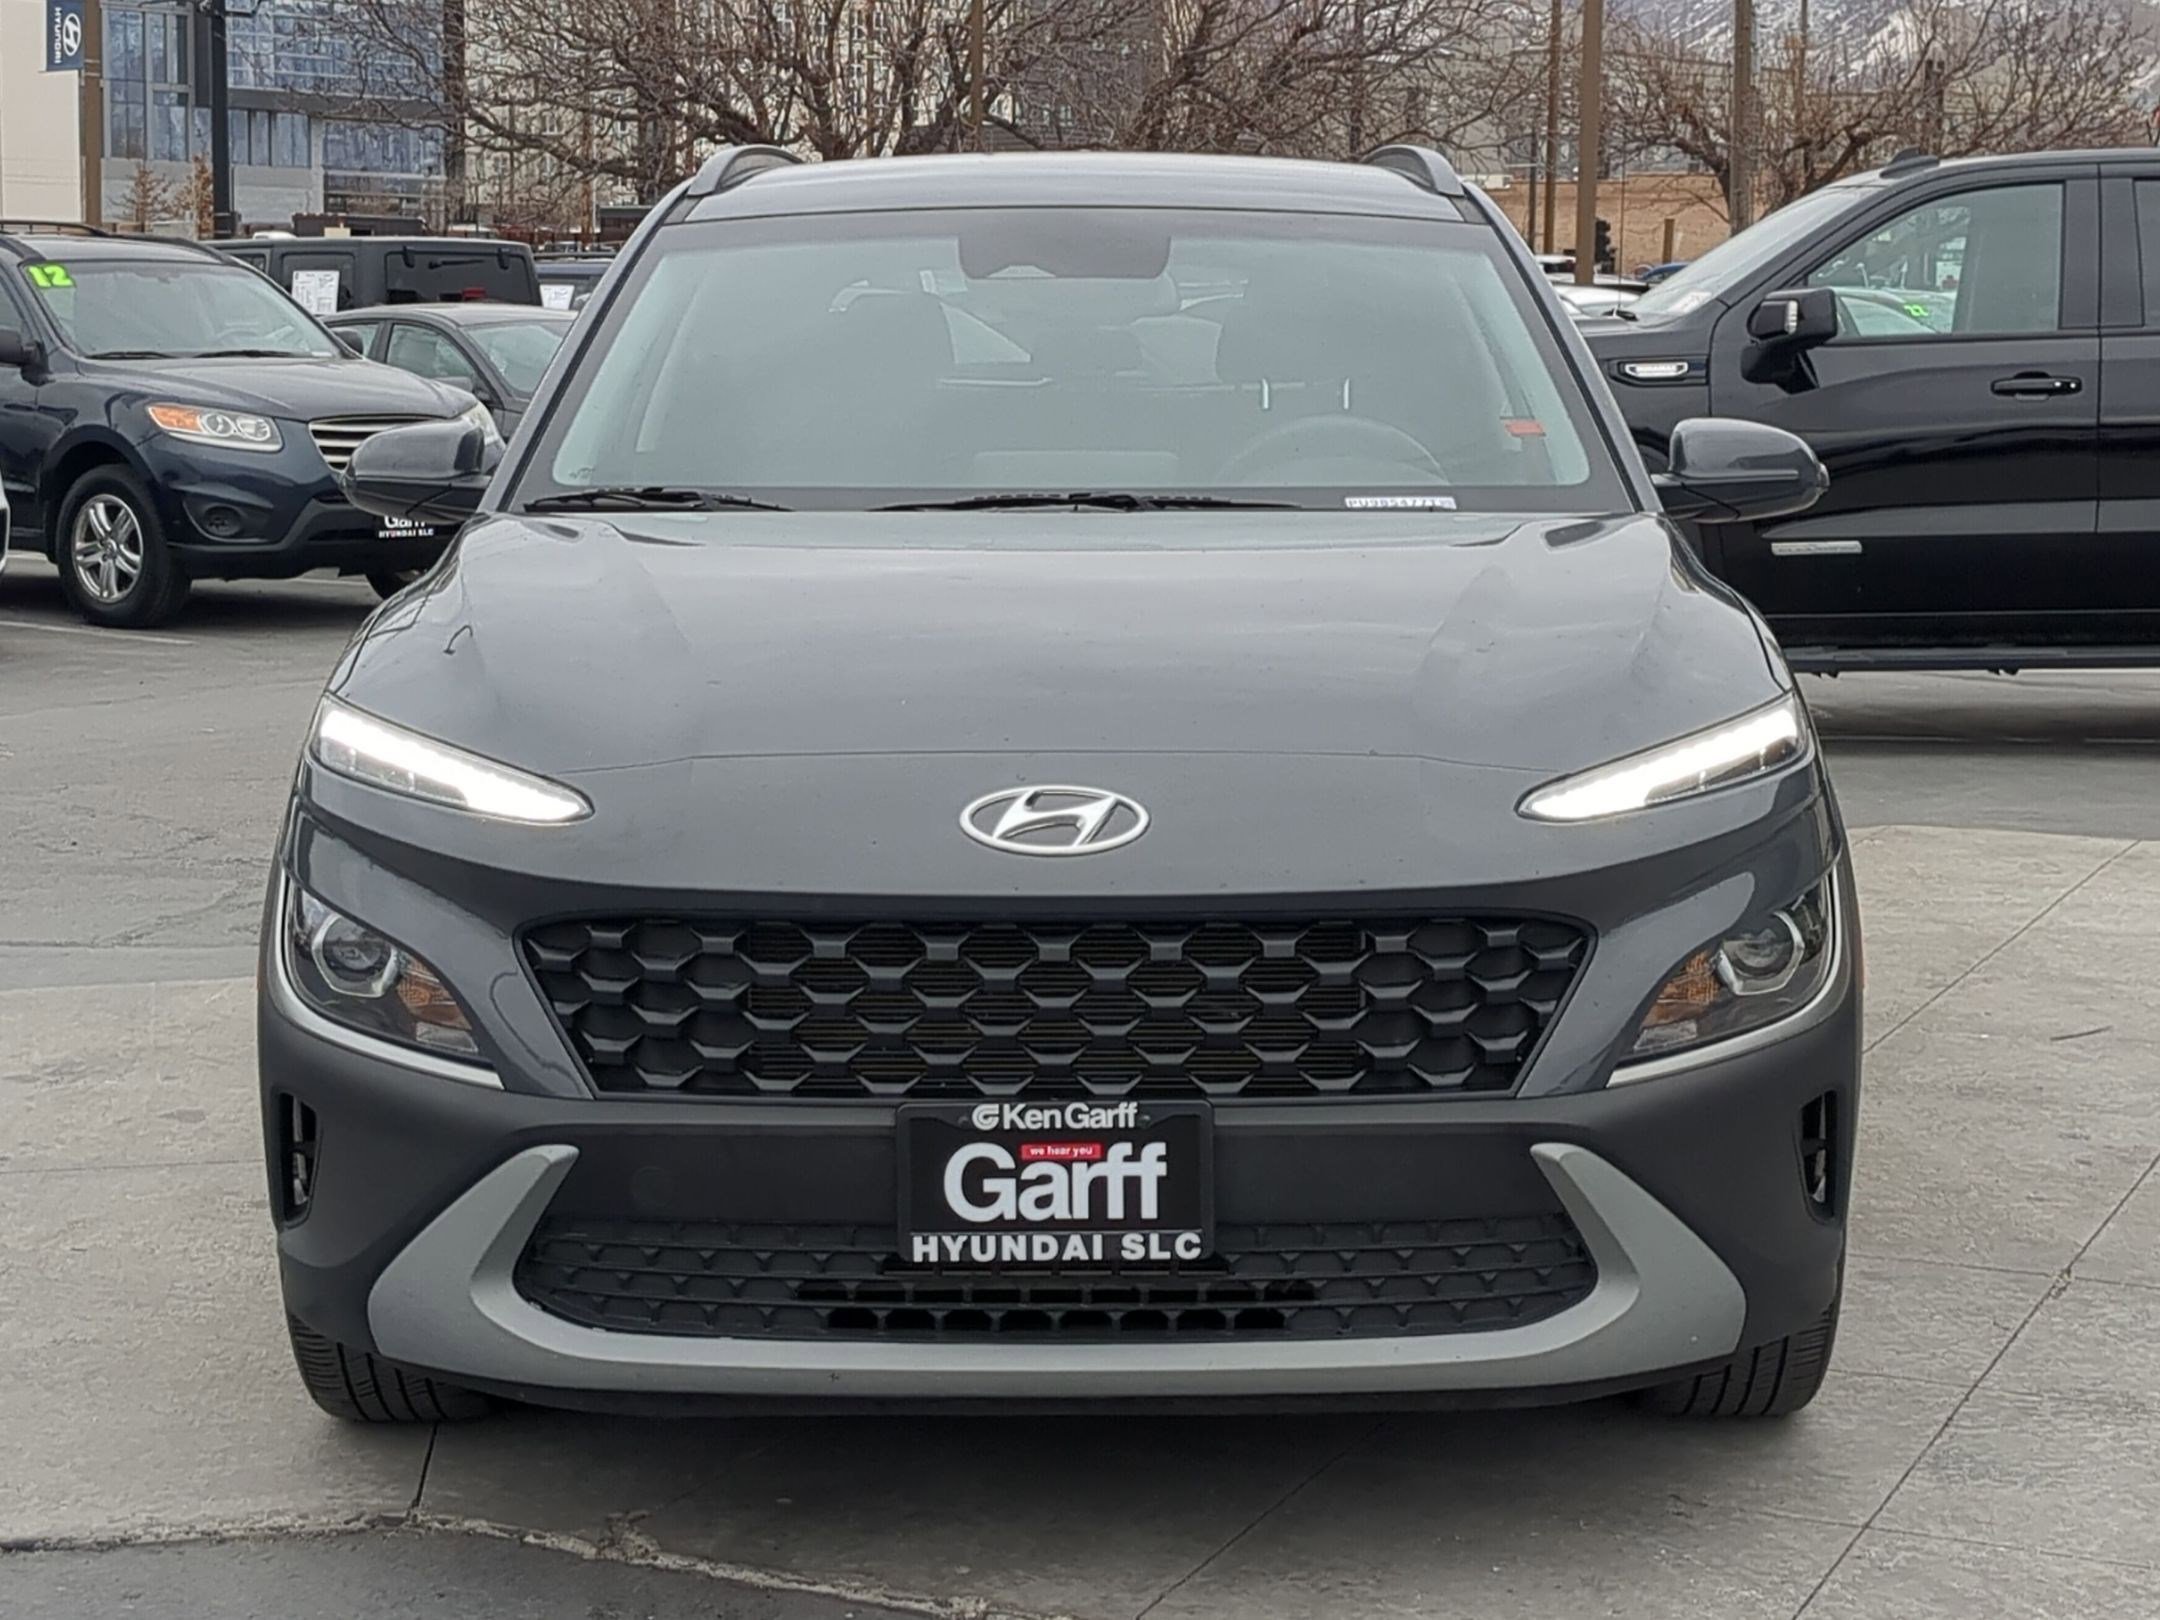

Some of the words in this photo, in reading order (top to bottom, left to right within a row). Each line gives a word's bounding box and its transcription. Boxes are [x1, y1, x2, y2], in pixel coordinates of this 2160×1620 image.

[54, 7, 62, 64] HYUNDAI
[29, 265, 73, 287] 12
[1003, 1103, 1062, 1130] Ken
[1064, 1102, 1138, 1129] Garff
[1030, 1148, 1045, 1156] we
[1047, 1146, 1071, 1156] hear
[1072, 1146, 1093, 1158] you
[943, 1142, 1167, 1222] Garff
[912, 1233, 1103, 1262] HYUNDAI
[1120, 1232, 1201, 1260] SLC
